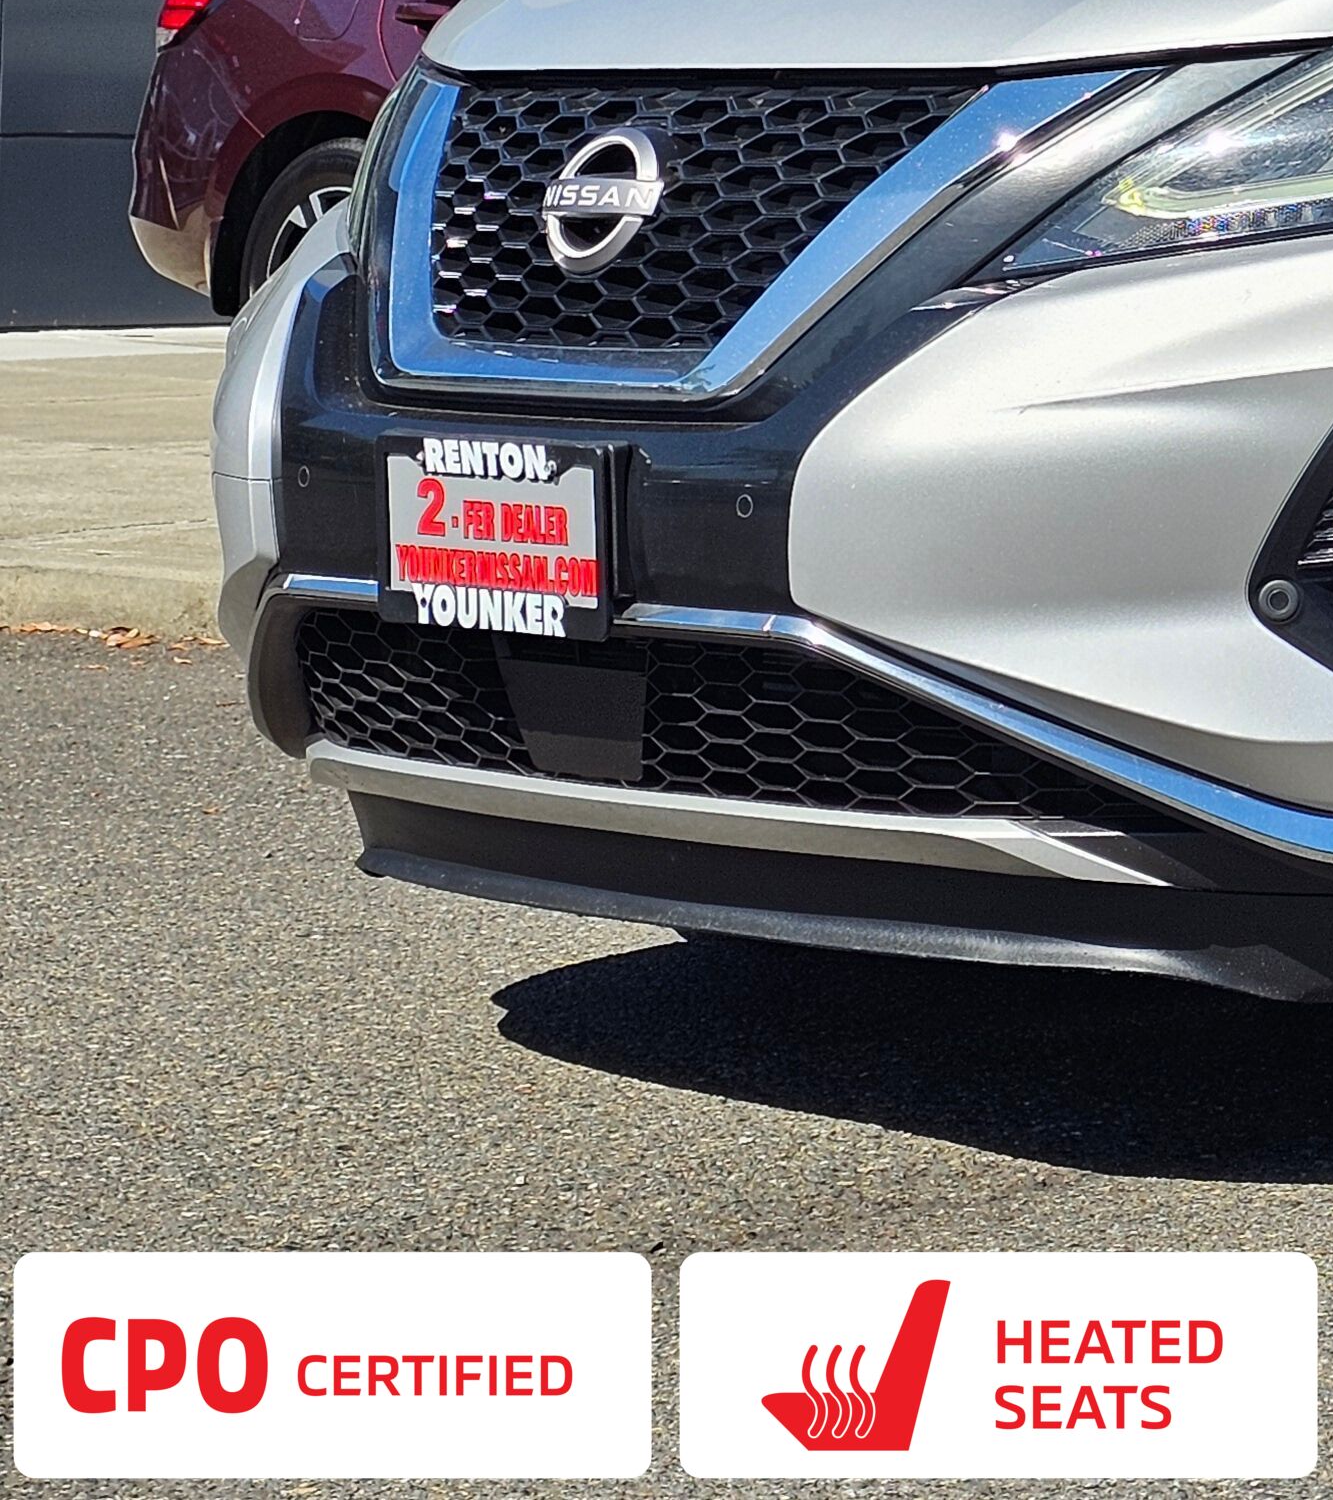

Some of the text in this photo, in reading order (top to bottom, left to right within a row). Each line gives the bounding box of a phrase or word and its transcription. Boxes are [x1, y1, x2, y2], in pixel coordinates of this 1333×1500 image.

[543, 180, 656, 209] NISSAN
[422, 437, 549, 481] RENTON
[500, 502, 569, 547] DEALER
[395, 543, 600, 598] YOUNKERNISSAN.COM
[410, 582, 566, 638] YOUNKER
